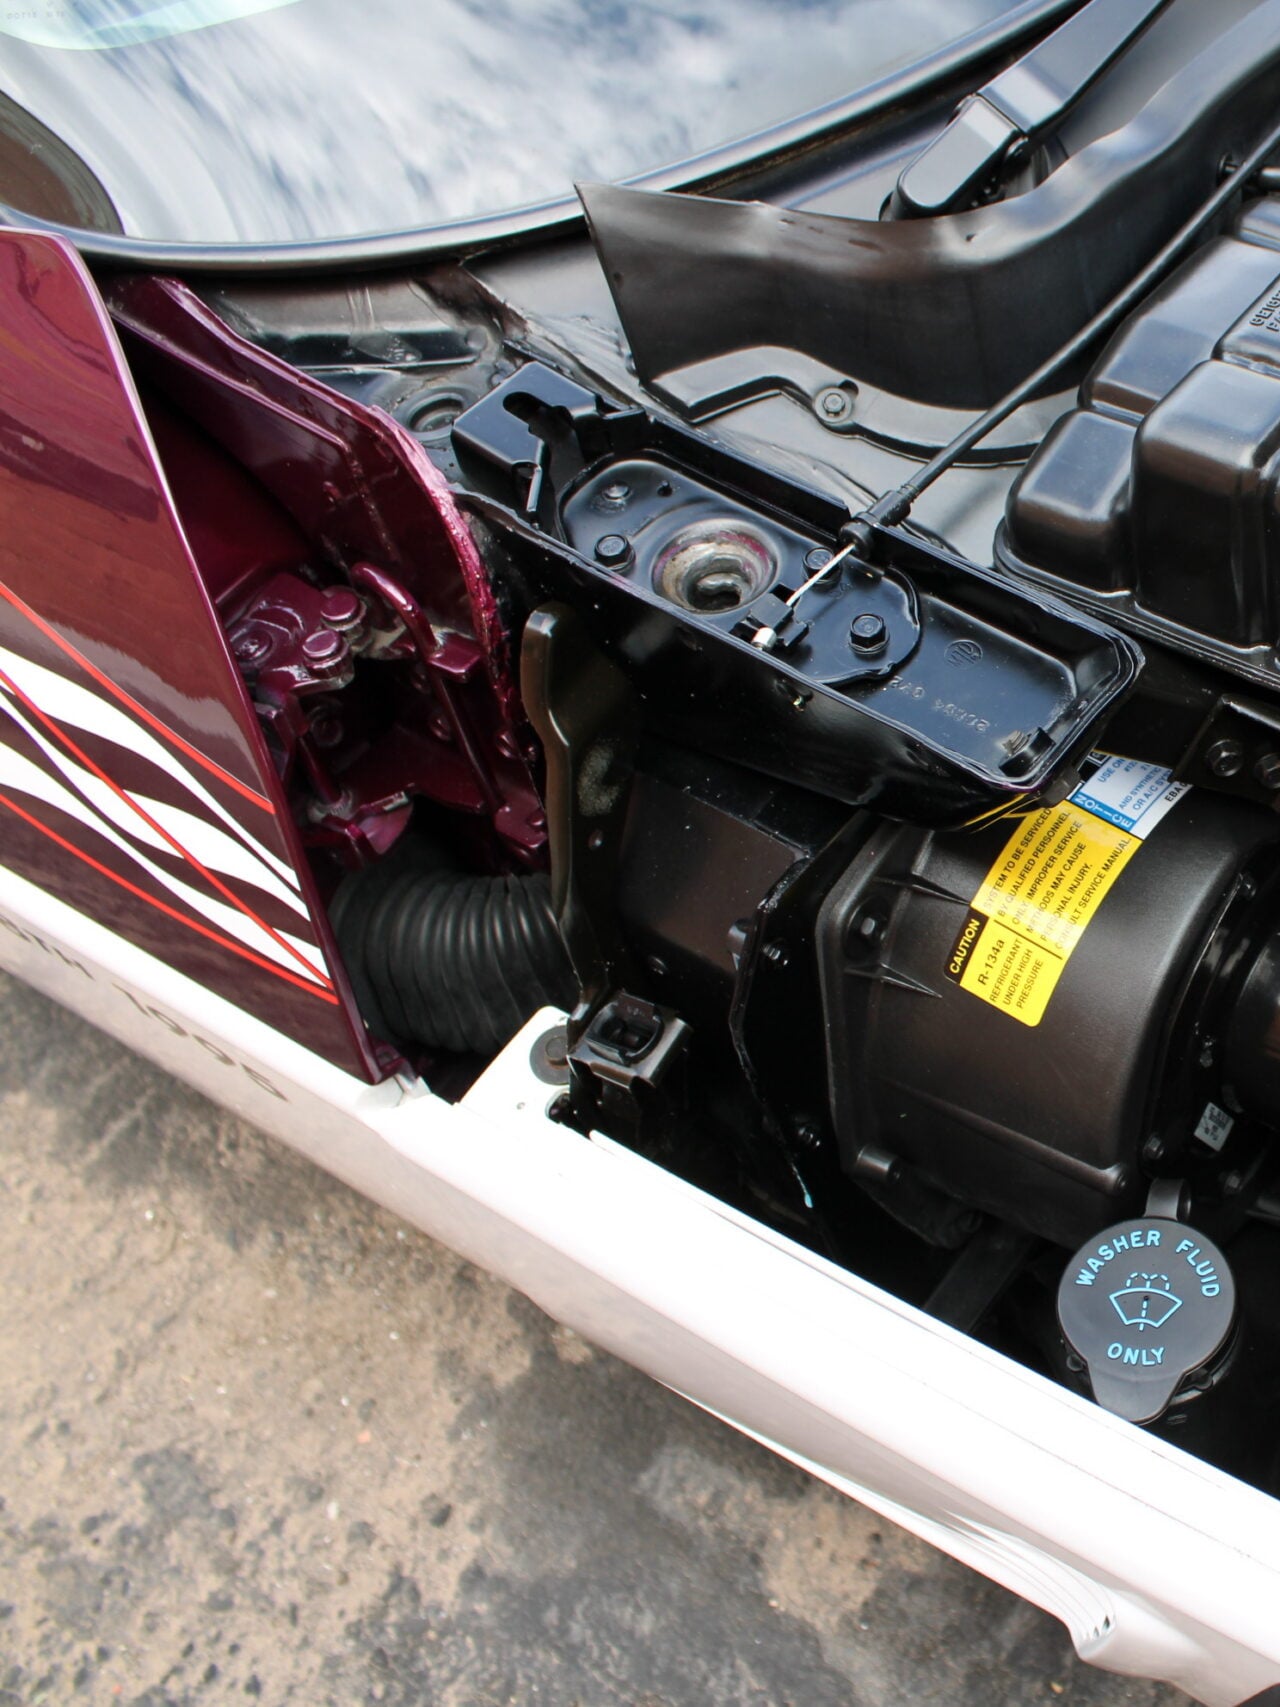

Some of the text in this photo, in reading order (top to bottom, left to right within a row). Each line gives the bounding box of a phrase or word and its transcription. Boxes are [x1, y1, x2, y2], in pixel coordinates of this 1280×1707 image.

[1097, 766, 1115, 784] USE
[1118, 793, 1133, 809] AND
[1132, 797, 1145, 811] OR
[1143, 784, 1158, 799] A/C
[1164, 785, 1182, 802] EBA
[1074, 793, 1132, 828] NOTICE
[983, 805, 1051, 909] SYSTEM TO BE SERVICED
[996, 808, 1070, 917] BY QUALIFIED PERSONNEL
[1024, 854, 1058, 900] IMPROPER
[1053, 819, 1081, 856] SERVICE
[1023, 841, 1086, 933] METHODS MAY CAUSE
[1037, 861, 1093, 941] PERSONAL INJURY.
[1052, 834, 1131, 949] CONSULT SERVICE MANUAL.
[948, 919, 980, 973] CAUTION
[977, 938, 1005, 984] R-134a
[988, 939, 1022, 1001] REFRIGERANT
[1002, 948, 1033, 1004] UNDER HIGH
[1016, 960, 1044, 1008] PRESSURE
[112, 983, 289, 1101] 1995
[1075, 1230, 1220, 1297] WASHER FLUID
[1107, 1342, 1165, 1366] ONLY
